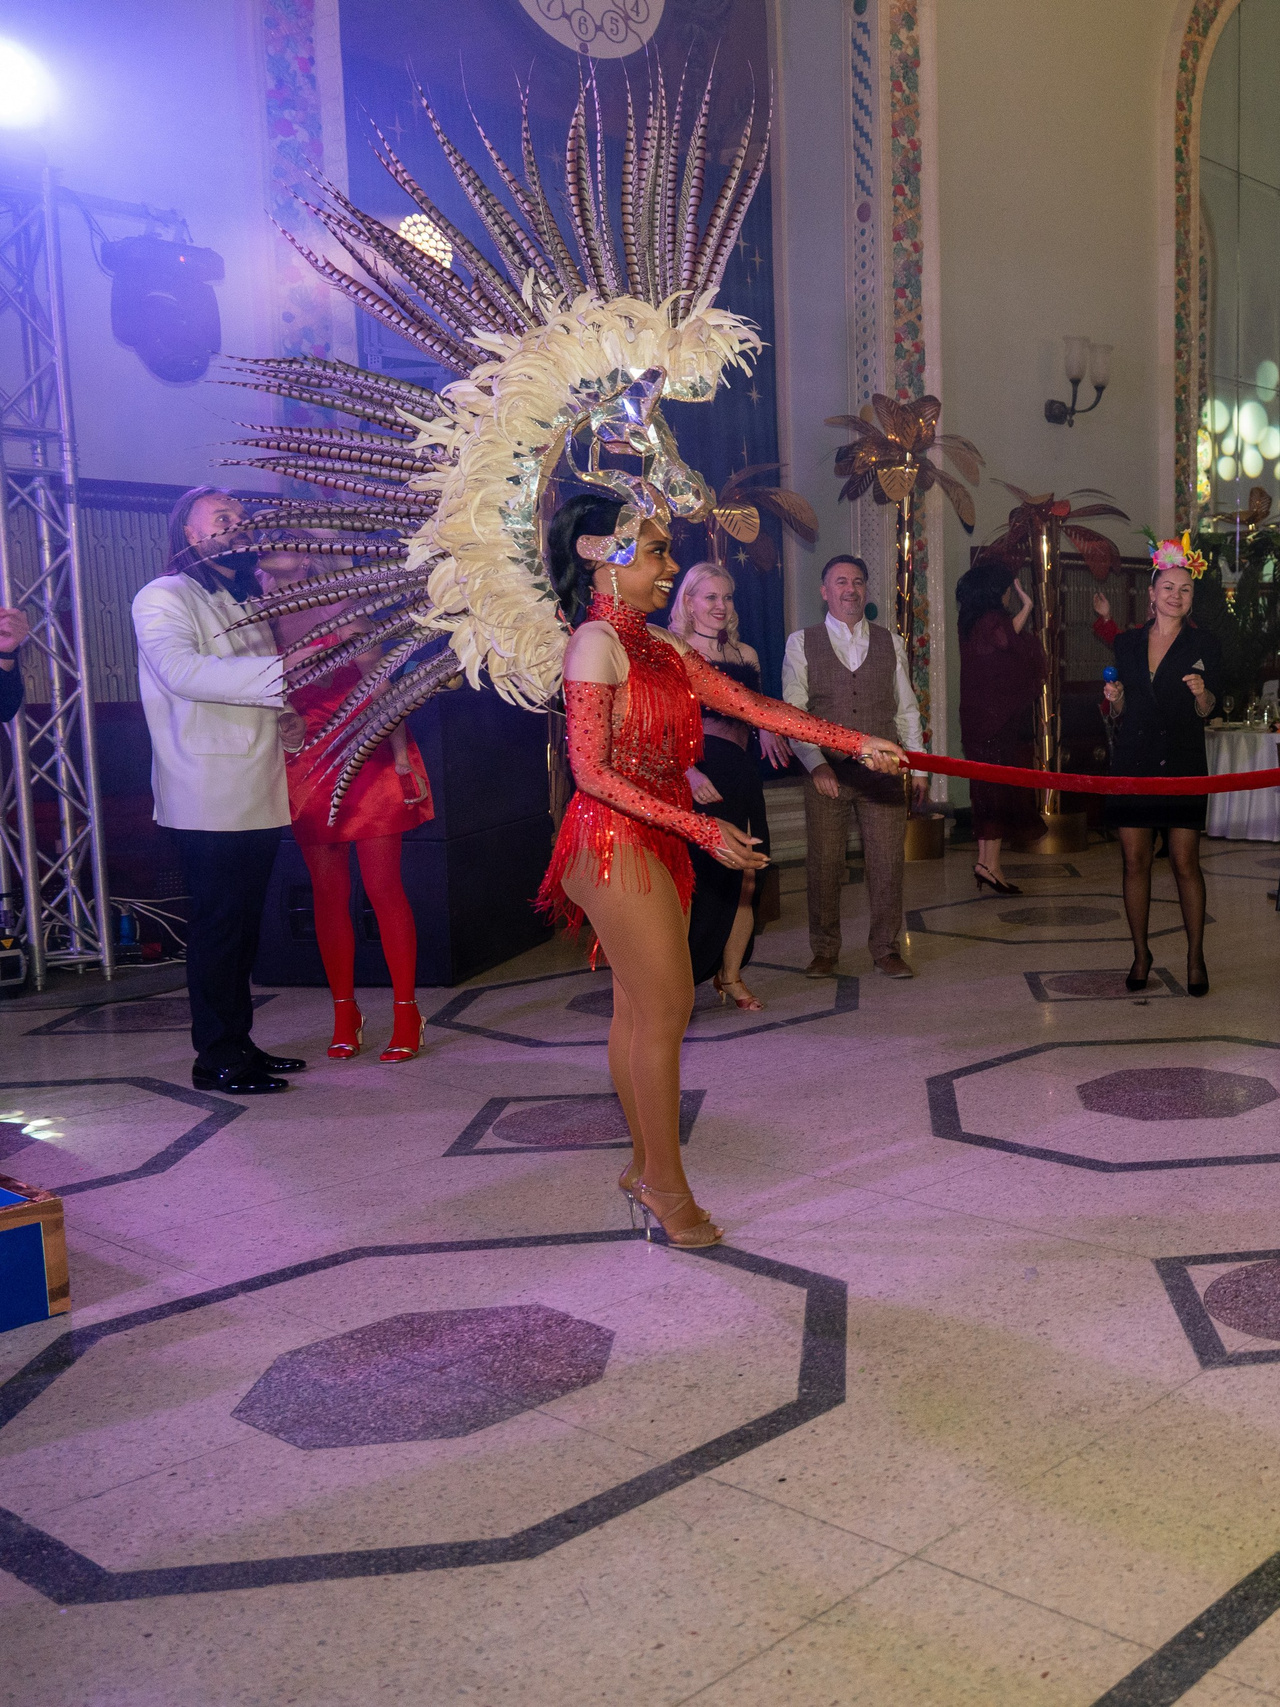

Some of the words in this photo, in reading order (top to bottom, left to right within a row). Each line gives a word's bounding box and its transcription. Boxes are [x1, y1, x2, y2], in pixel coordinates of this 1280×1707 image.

[630, 0, 640, 17] 4
[578, 15, 588, 35] 6
[610, 16, 619, 36] 5
